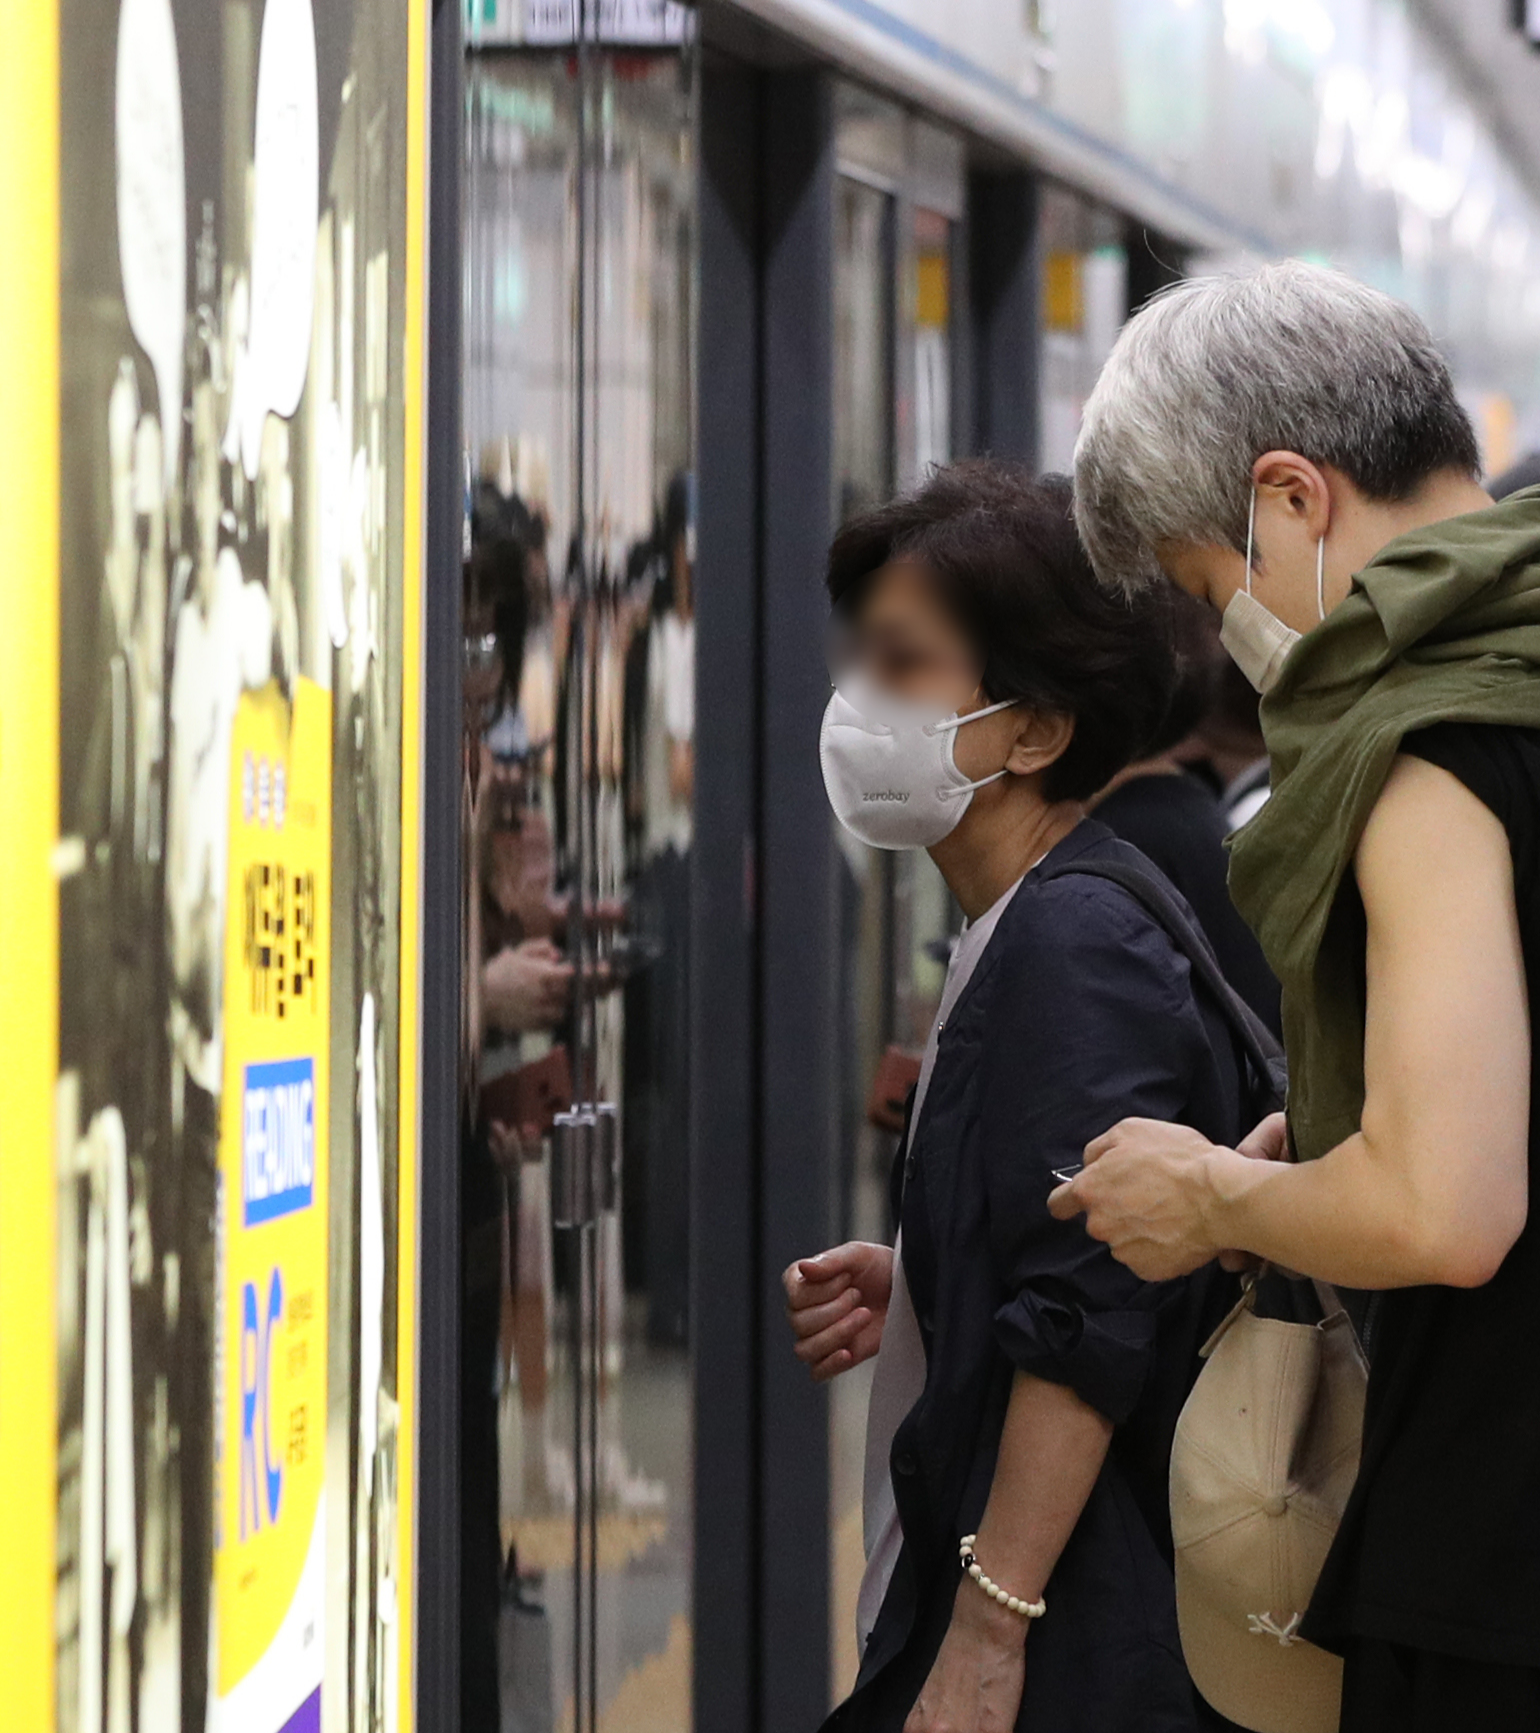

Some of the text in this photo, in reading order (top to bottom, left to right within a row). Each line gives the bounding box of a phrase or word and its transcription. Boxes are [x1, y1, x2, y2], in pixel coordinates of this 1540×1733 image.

[862, 789, 910, 805] zerobay
[245, 1078, 312, 1203] READING
[241, 1266, 282, 1543] RC
